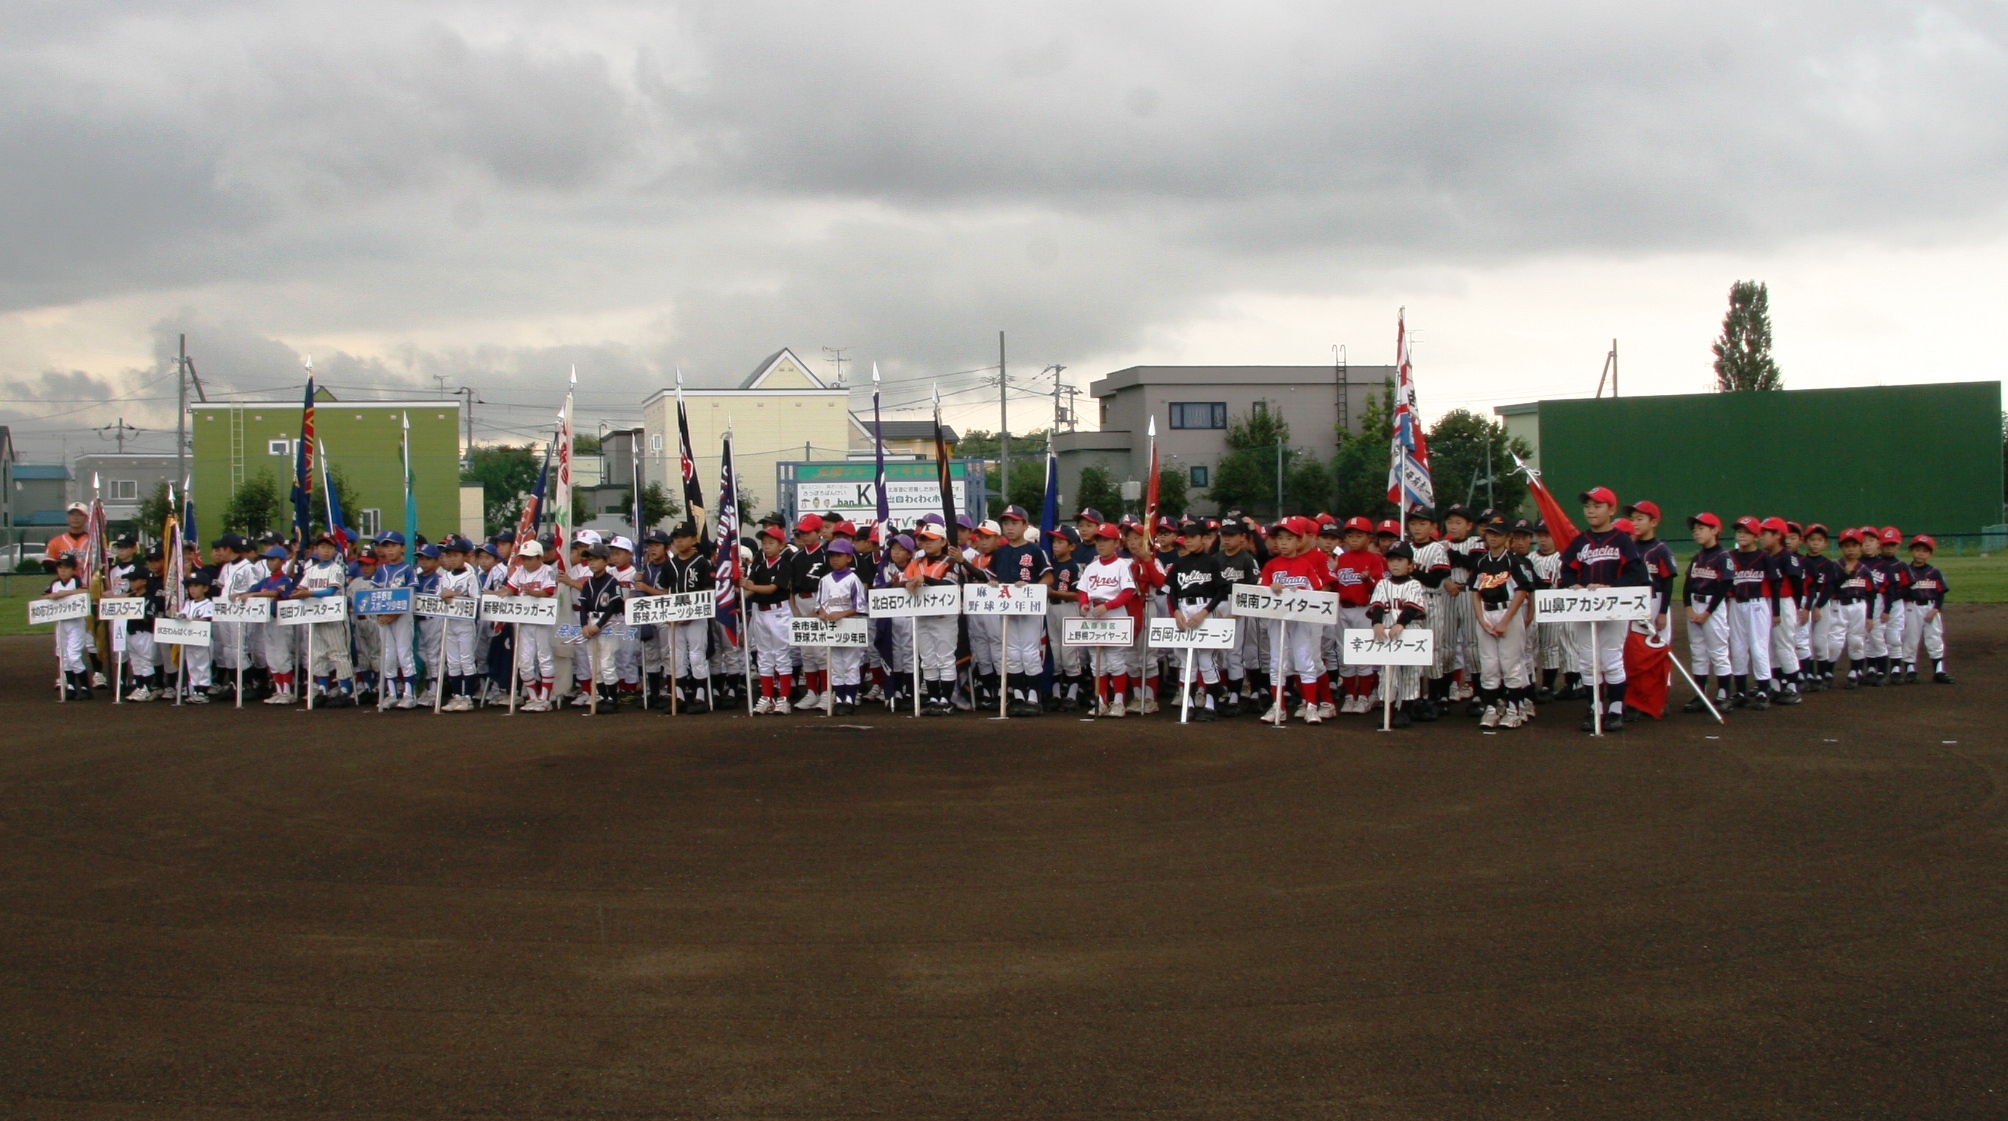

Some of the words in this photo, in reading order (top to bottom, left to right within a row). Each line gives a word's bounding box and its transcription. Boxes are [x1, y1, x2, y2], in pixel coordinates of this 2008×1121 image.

[1577, 543, 1620, 566] Acacias
[279, 601, 342, 620] 屯田ブルースターズ
[483, 600, 556, 617] 新琴似スラッガーズ
[871, 594, 956, 611] 北白石ワイルドナイン
[1235, 591, 1334, 616] 幌南ファイターズ
[1538, 594, 1648, 614] 山鼻アカシアーズ
[632, 604, 712, 624] 野球スポーツ少年団
[794, 632, 867, 644] 野球スポーツ少年団
[1067, 630, 1129, 641] 上野幌ファイヤーズ
